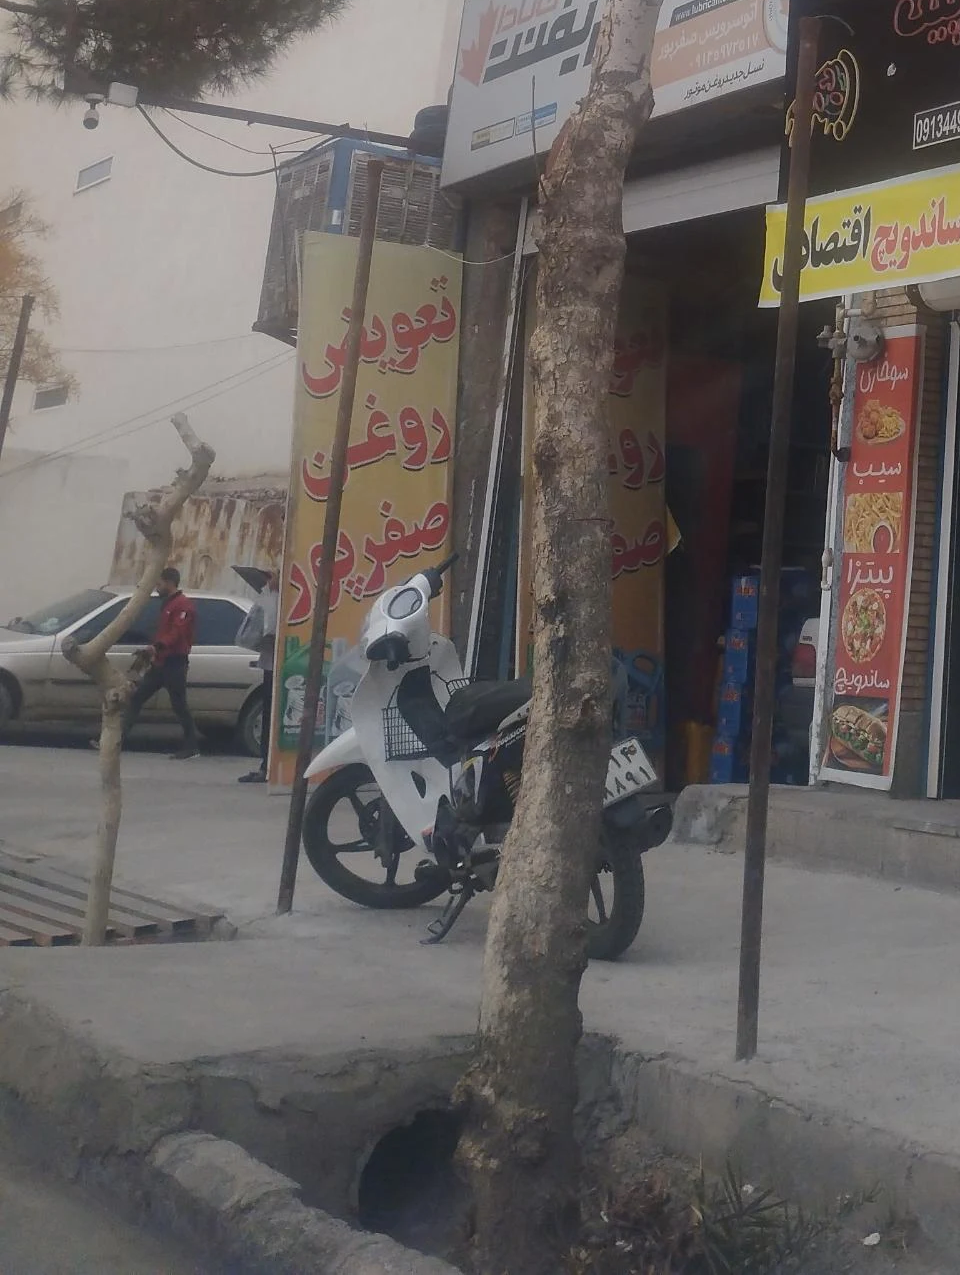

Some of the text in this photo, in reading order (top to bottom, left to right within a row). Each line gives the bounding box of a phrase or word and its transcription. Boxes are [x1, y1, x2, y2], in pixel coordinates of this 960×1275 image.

[859, 352, 909, 393] سوخاری
[303, 392, 451, 501] روغن
[852, 460, 902, 485] سیب
[288, 500, 451, 624] صفرپور
[847, 558, 894, 600] پیتزا
[833, 667, 891, 696] ساندویچ
